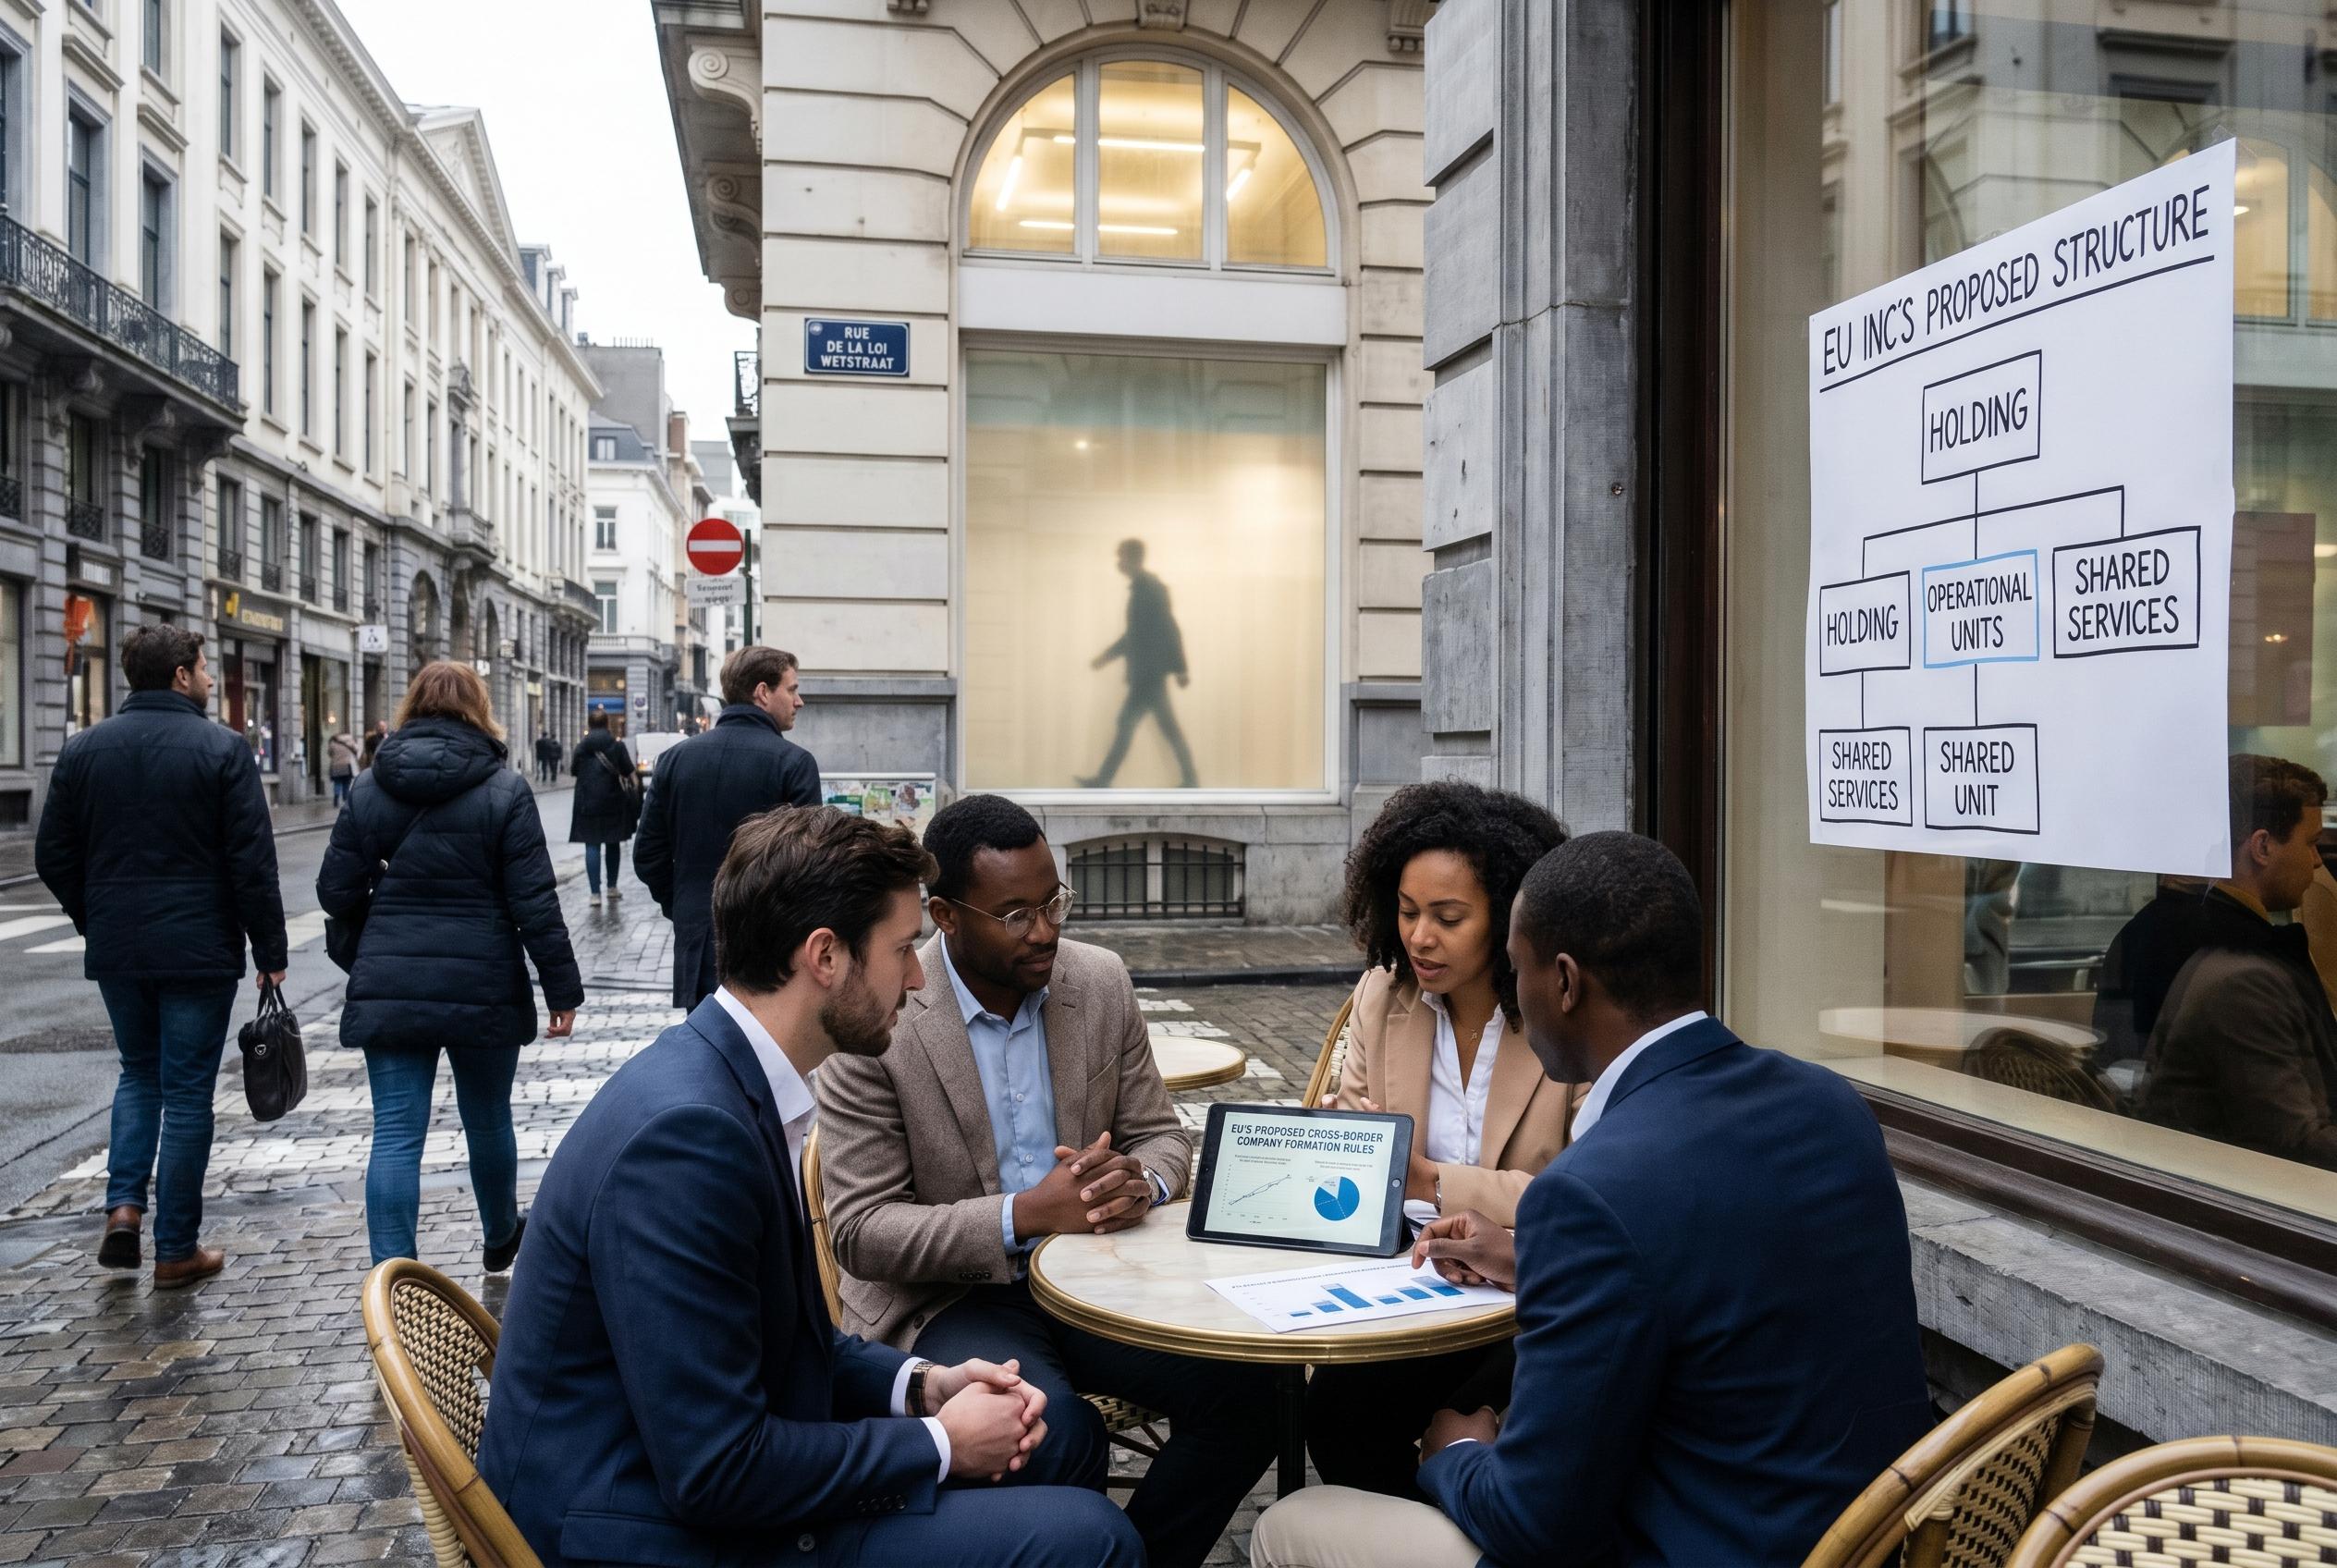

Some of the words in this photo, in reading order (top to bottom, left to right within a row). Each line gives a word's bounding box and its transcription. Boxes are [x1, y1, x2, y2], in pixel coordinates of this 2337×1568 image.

[1823, 321, 1852, 376] EU
[1927, 252, 2039, 336] PROPOSED
[2052, 184, 2210, 288] STRUCTURE
[826, 340, 843, 353] DE
[848, 341, 863, 353] LA
[868, 342, 887, 355] LOI
[844, 326, 870, 339] RUE
[820, 355, 894, 369] WETSTRAAT
[1930, 387, 2028, 454] HOLDING
[2074, 548, 2171, 595] SHARED
[1927, 571, 2033, 614] OPERATIONAL
[1827, 604, 1899, 647] HOLDING
[1951, 616, 2004, 652] UNITS
[2067, 594, 2180, 642] SERVICES
[1831, 741, 1892, 771] SHARED
[1939, 741, 2015, 774] SHARED
[1828, 778, 1899, 811] SERVICES
[1954, 783, 2000, 816] UNIT
[1230, 1124, 1253, 1134] EU'S
[1254, 1125, 1305, 1137] PROPOSED
[1307, 1129, 1384, 1143] CROSS-BORDER
[1237, 1136, 1283, 1148] COMPANY
[1284, 1139, 1341, 1152] FORMATION
[1342, 1143, 1375, 1155] RULES
